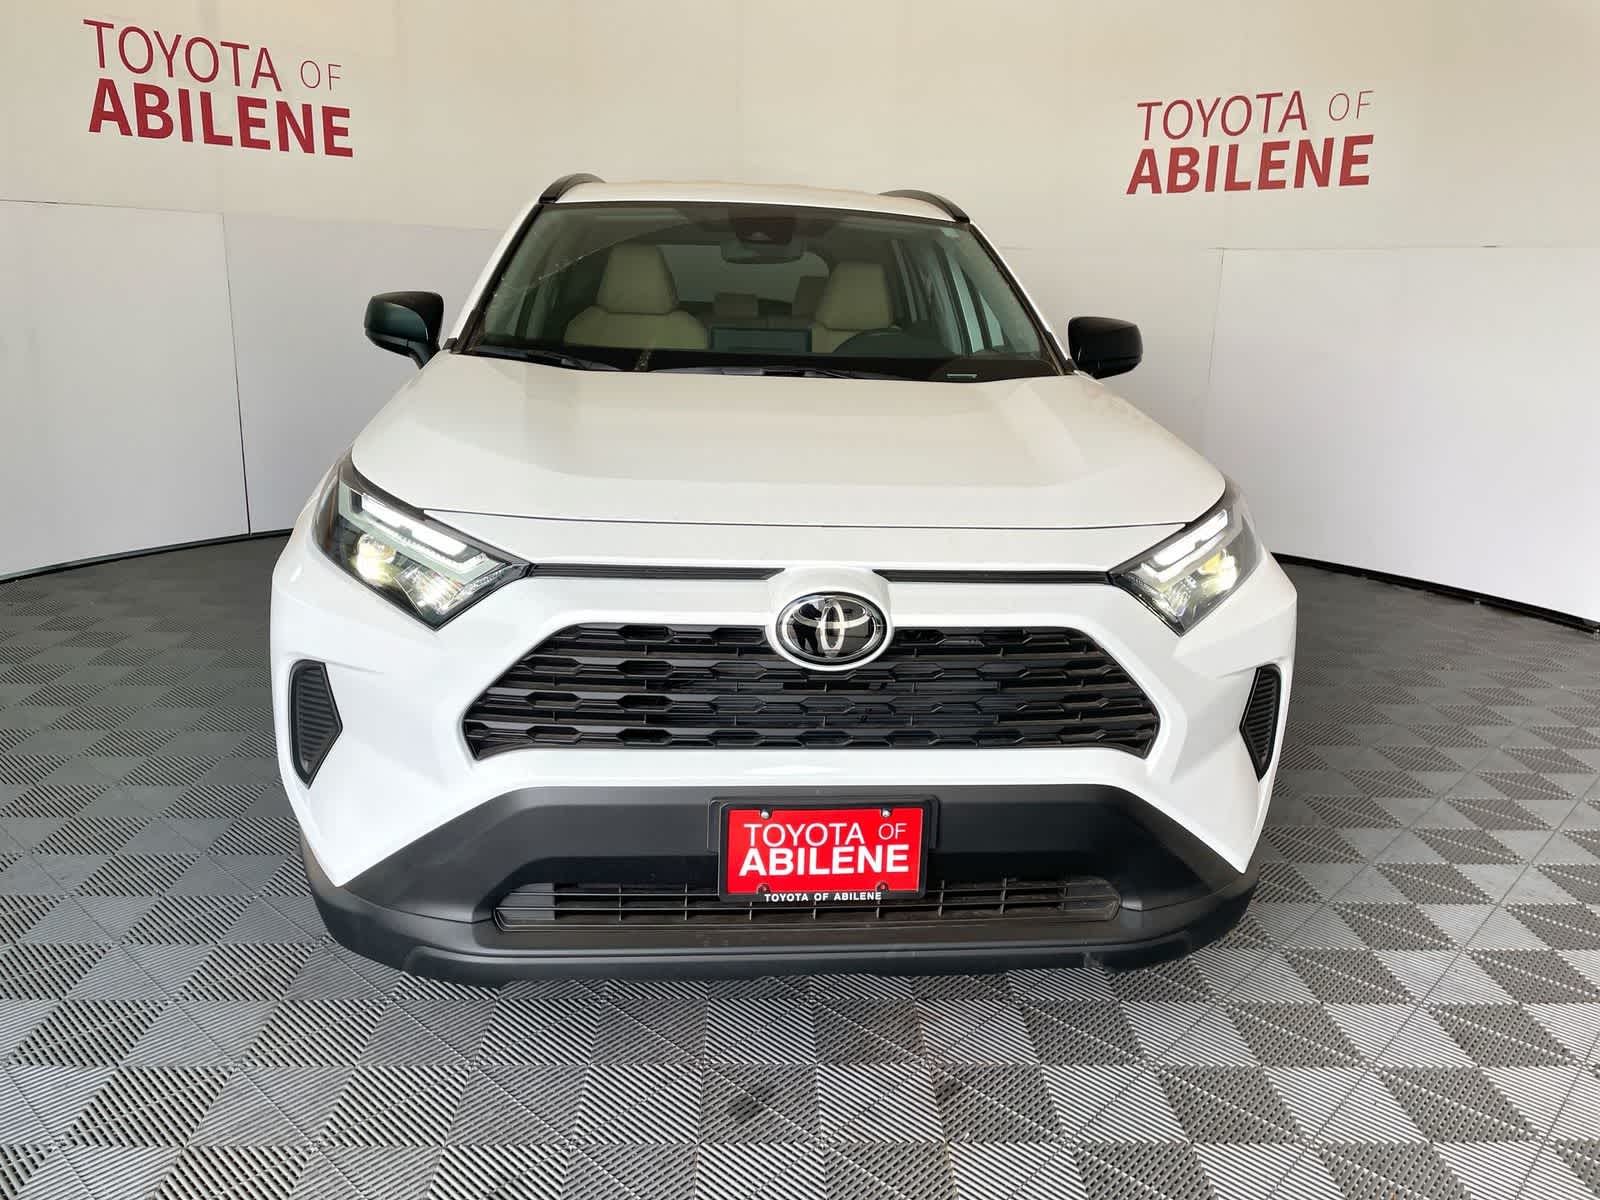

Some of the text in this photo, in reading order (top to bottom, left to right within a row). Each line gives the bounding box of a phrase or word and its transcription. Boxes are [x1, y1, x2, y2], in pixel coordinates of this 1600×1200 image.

[82, 18, 342, 93] TOYOTA OF
[88, 76, 354, 159] ABILENE
[1136, 89, 1374, 142] TOYOTA OF
[1125, 133, 1375, 195] ABILENE
[738, 843, 910, 877] ABILENE
[743, 822, 908, 848] TOYOTA OF
[763, 891, 882, 903] TOYOTA OF ABILENE
